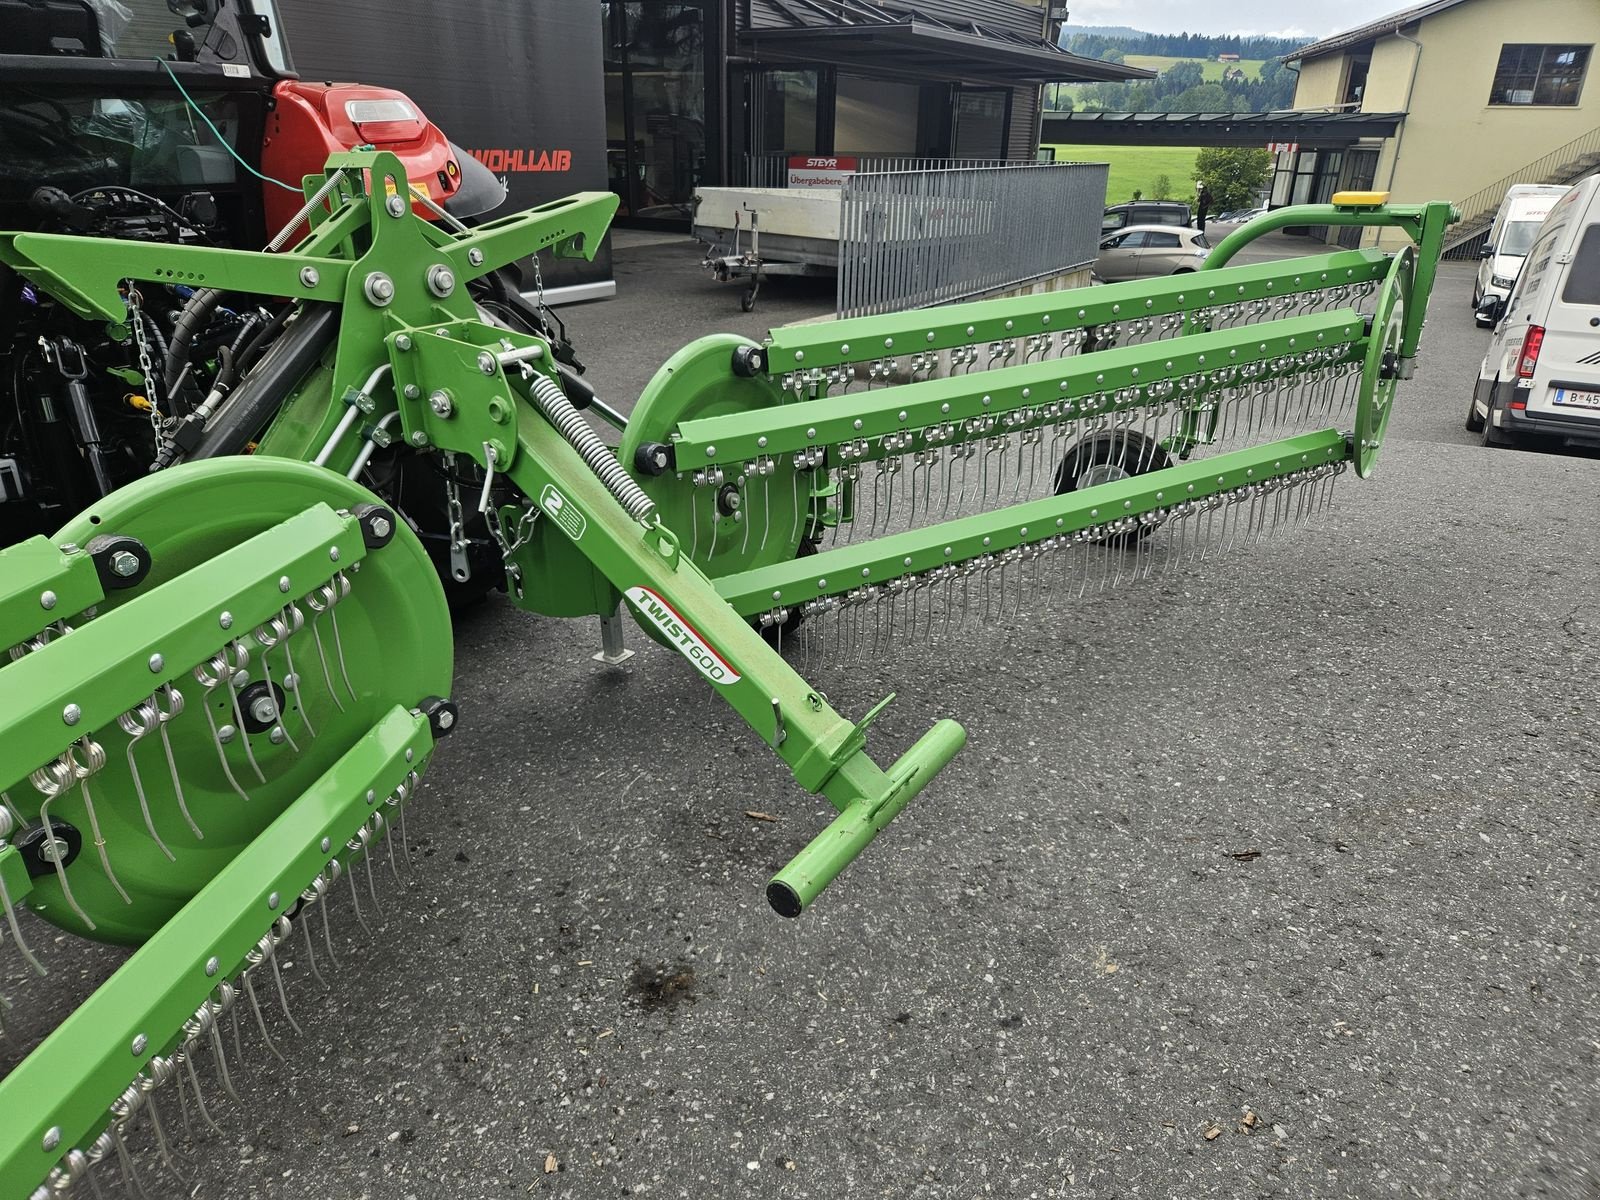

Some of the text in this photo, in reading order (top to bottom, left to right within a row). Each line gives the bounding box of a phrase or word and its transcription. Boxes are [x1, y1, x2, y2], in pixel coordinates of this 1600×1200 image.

[806, 158, 838, 167] STEYR
[790, 173, 842, 186] Übergabebere
[1570, 392, 1578, 402] B
[544, 489, 563, 517] 2
